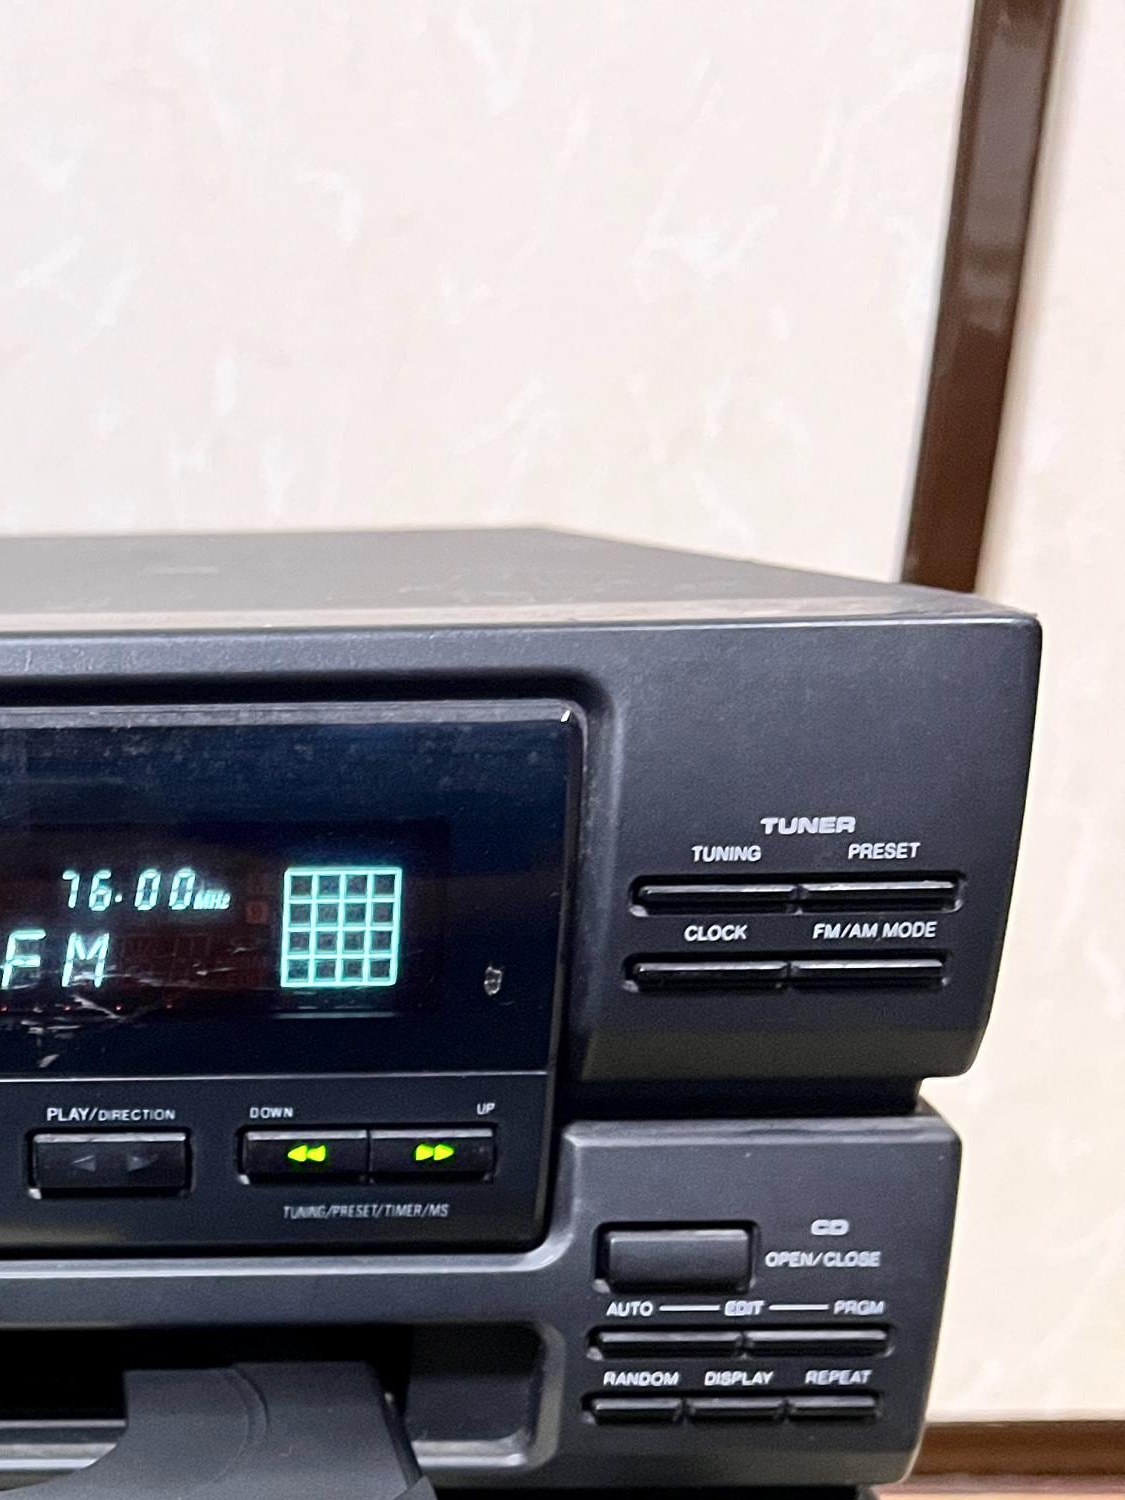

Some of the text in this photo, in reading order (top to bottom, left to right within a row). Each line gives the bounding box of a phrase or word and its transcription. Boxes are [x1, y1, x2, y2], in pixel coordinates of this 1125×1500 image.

[760, 817, 856, 834] TUNER
[691, 845, 762, 862] TUNING
[847, 842, 921, 859] PRESET
[684, 924, 747, 941] CLOCK
[812, 921, 938, 939] FM/AM MODE
[0, 929, 111, 989] FM
[46, 1107, 176, 1122] PLAY/DIRECTION
[249, 1107, 293, 1118] DOWN
[477, 1103, 495, 1115] UP
[283, 1205, 449, 1219] TUNING/PRESET/TIMER/MS
[765, 1251, 881, 1267] OPEN/CLOSE
[606, 1301, 653, 1316] AUTO
[725, 1301, 764, 1316] EDIT
[833, 1300, 885, 1315] PRGM
[603, 1371, 679, 1386] RANDOM
[704, 1370, 773, 1386] DISPLAY
[805, 1369, 872, 1384] REPEAT
